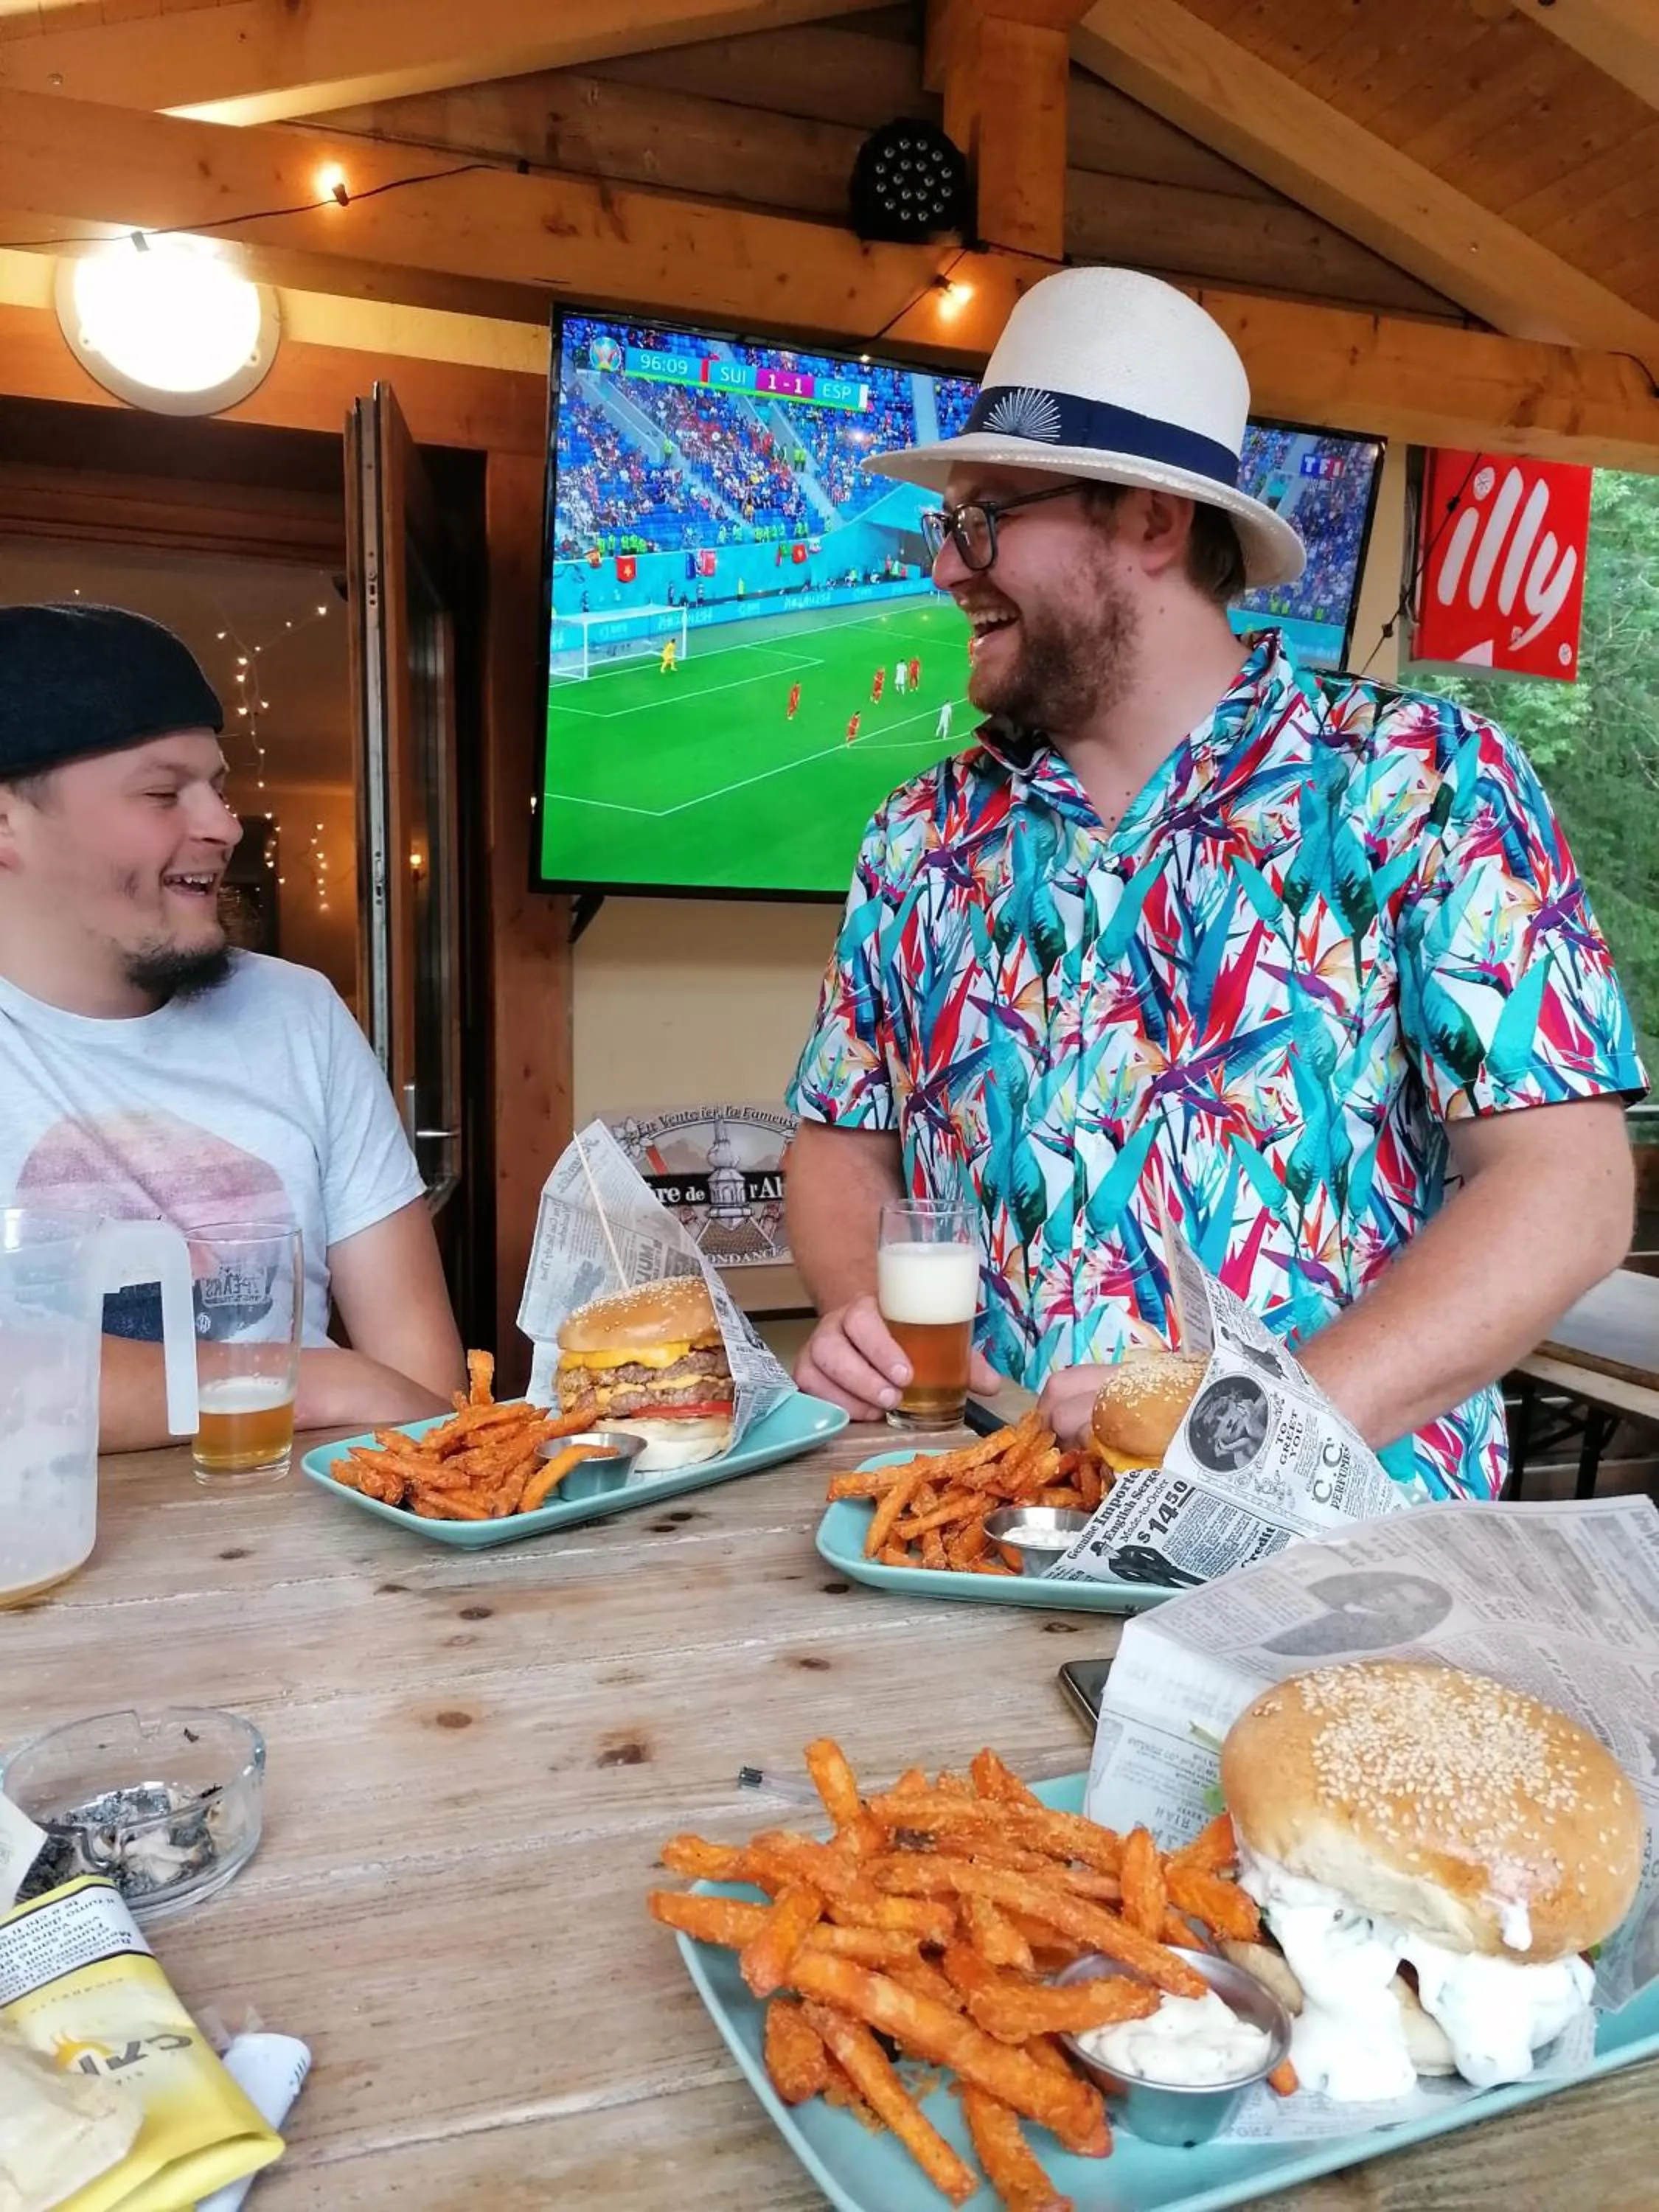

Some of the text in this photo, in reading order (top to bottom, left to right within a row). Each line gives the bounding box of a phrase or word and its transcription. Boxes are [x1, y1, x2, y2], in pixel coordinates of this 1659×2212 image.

[640, 353, 688, 375] 96:09
[720, 367, 747, 385] SUI
[822, 383, 852, 400] ESP
[1438, 466, 1578, 652] illy
[658, 1110, 698, 1128] Vente
[652, 1184, 680, 1203] re
[685, 1186, 705, 1201] de
[1067, 1468, 1144, 1559] Genuine Importe
[1102, 1470, 1161, 1542] English Serge
